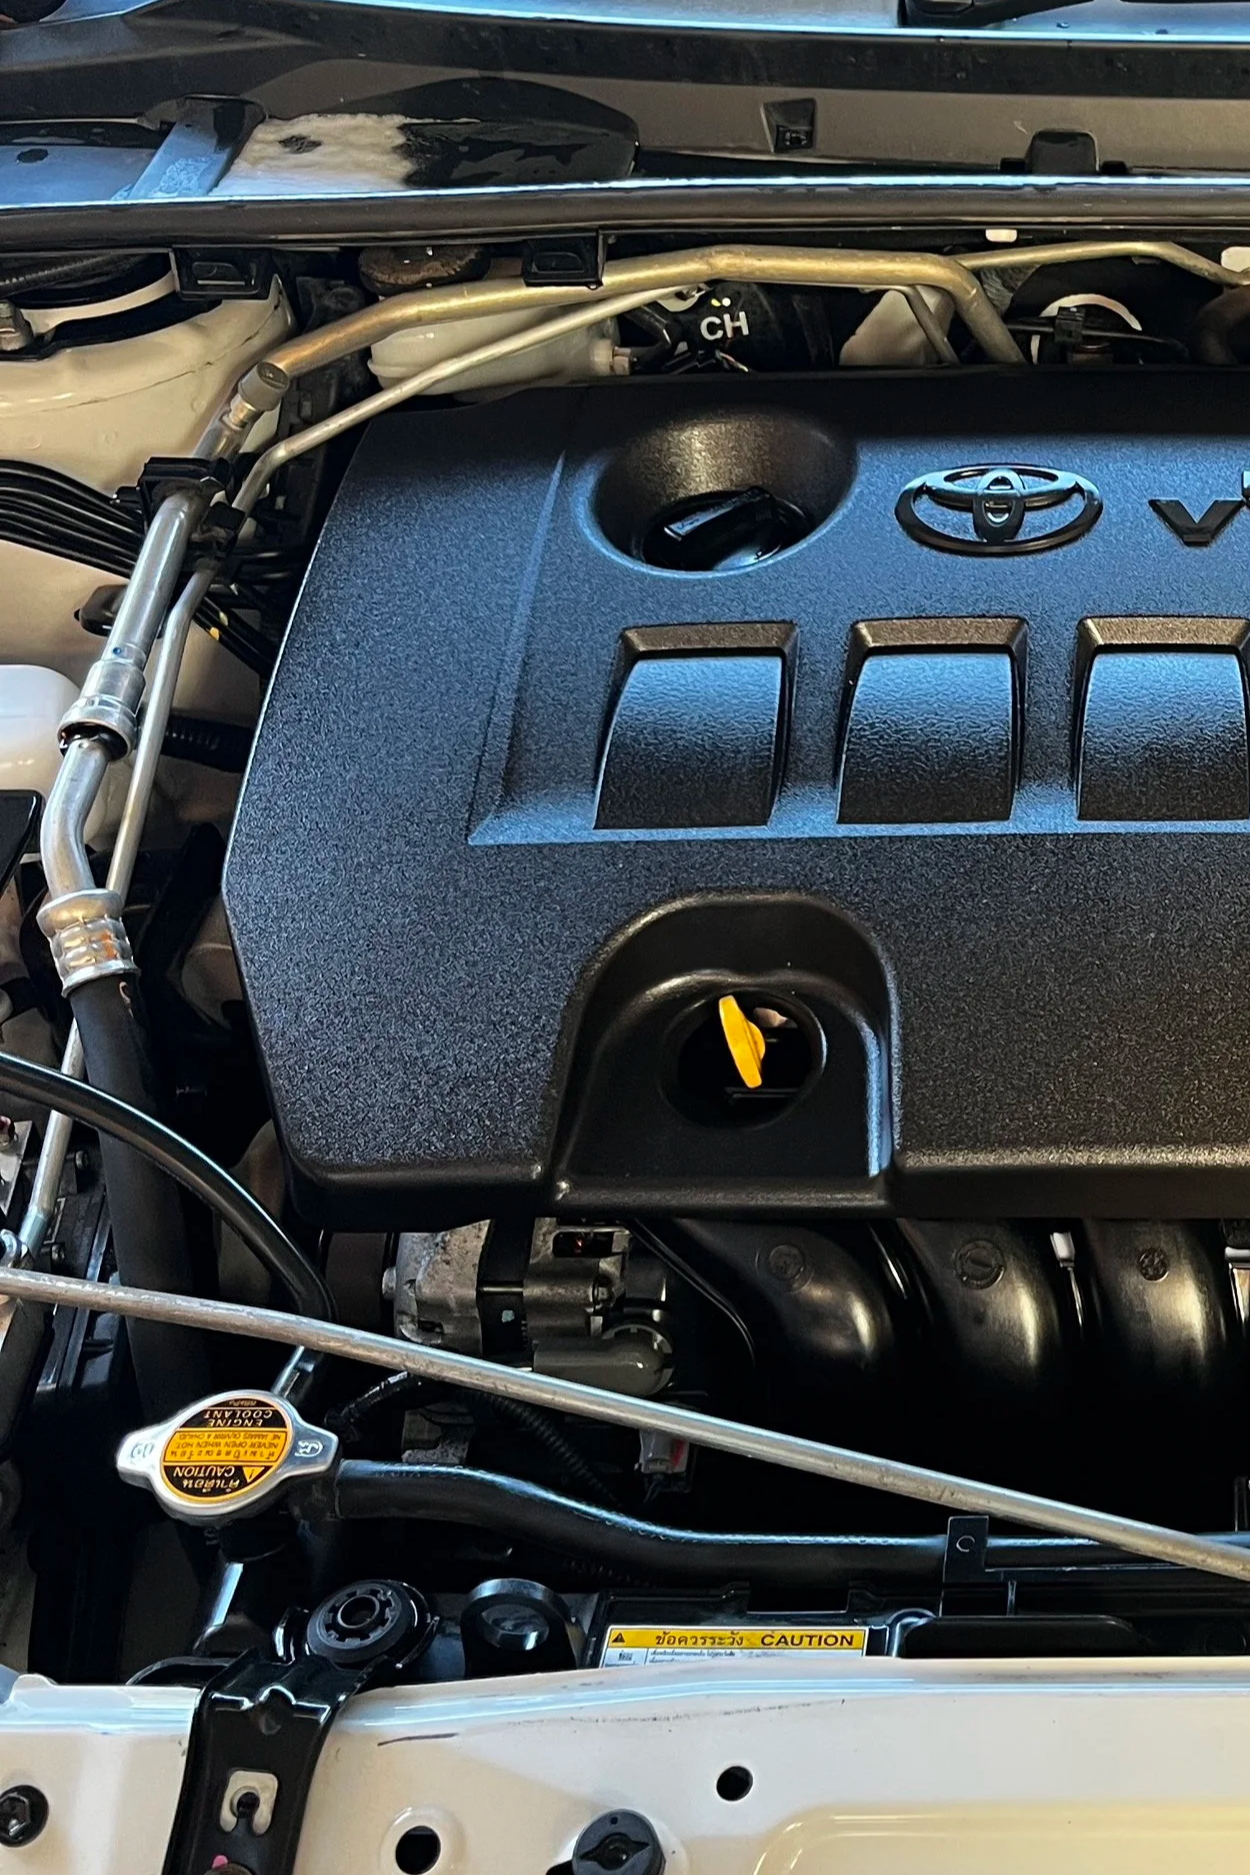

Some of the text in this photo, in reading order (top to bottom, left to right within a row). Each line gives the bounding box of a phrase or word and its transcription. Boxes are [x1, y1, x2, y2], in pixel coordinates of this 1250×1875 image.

[700, 311, 749, 340] CH
[203, 1410, 273, 1419] COOLANT
[208, 1419, 263, 1428] ENGINE
[197, 1440, 221, 1448] WHEN
[224, 1440, 247, 1448] OPEN
[250, 1441, 279, 1449] NEVER
[173, 1466, 235, 1477] CAUTION
[655, 1630, 855, 1647] ข้อควรระวัง CAUTION
